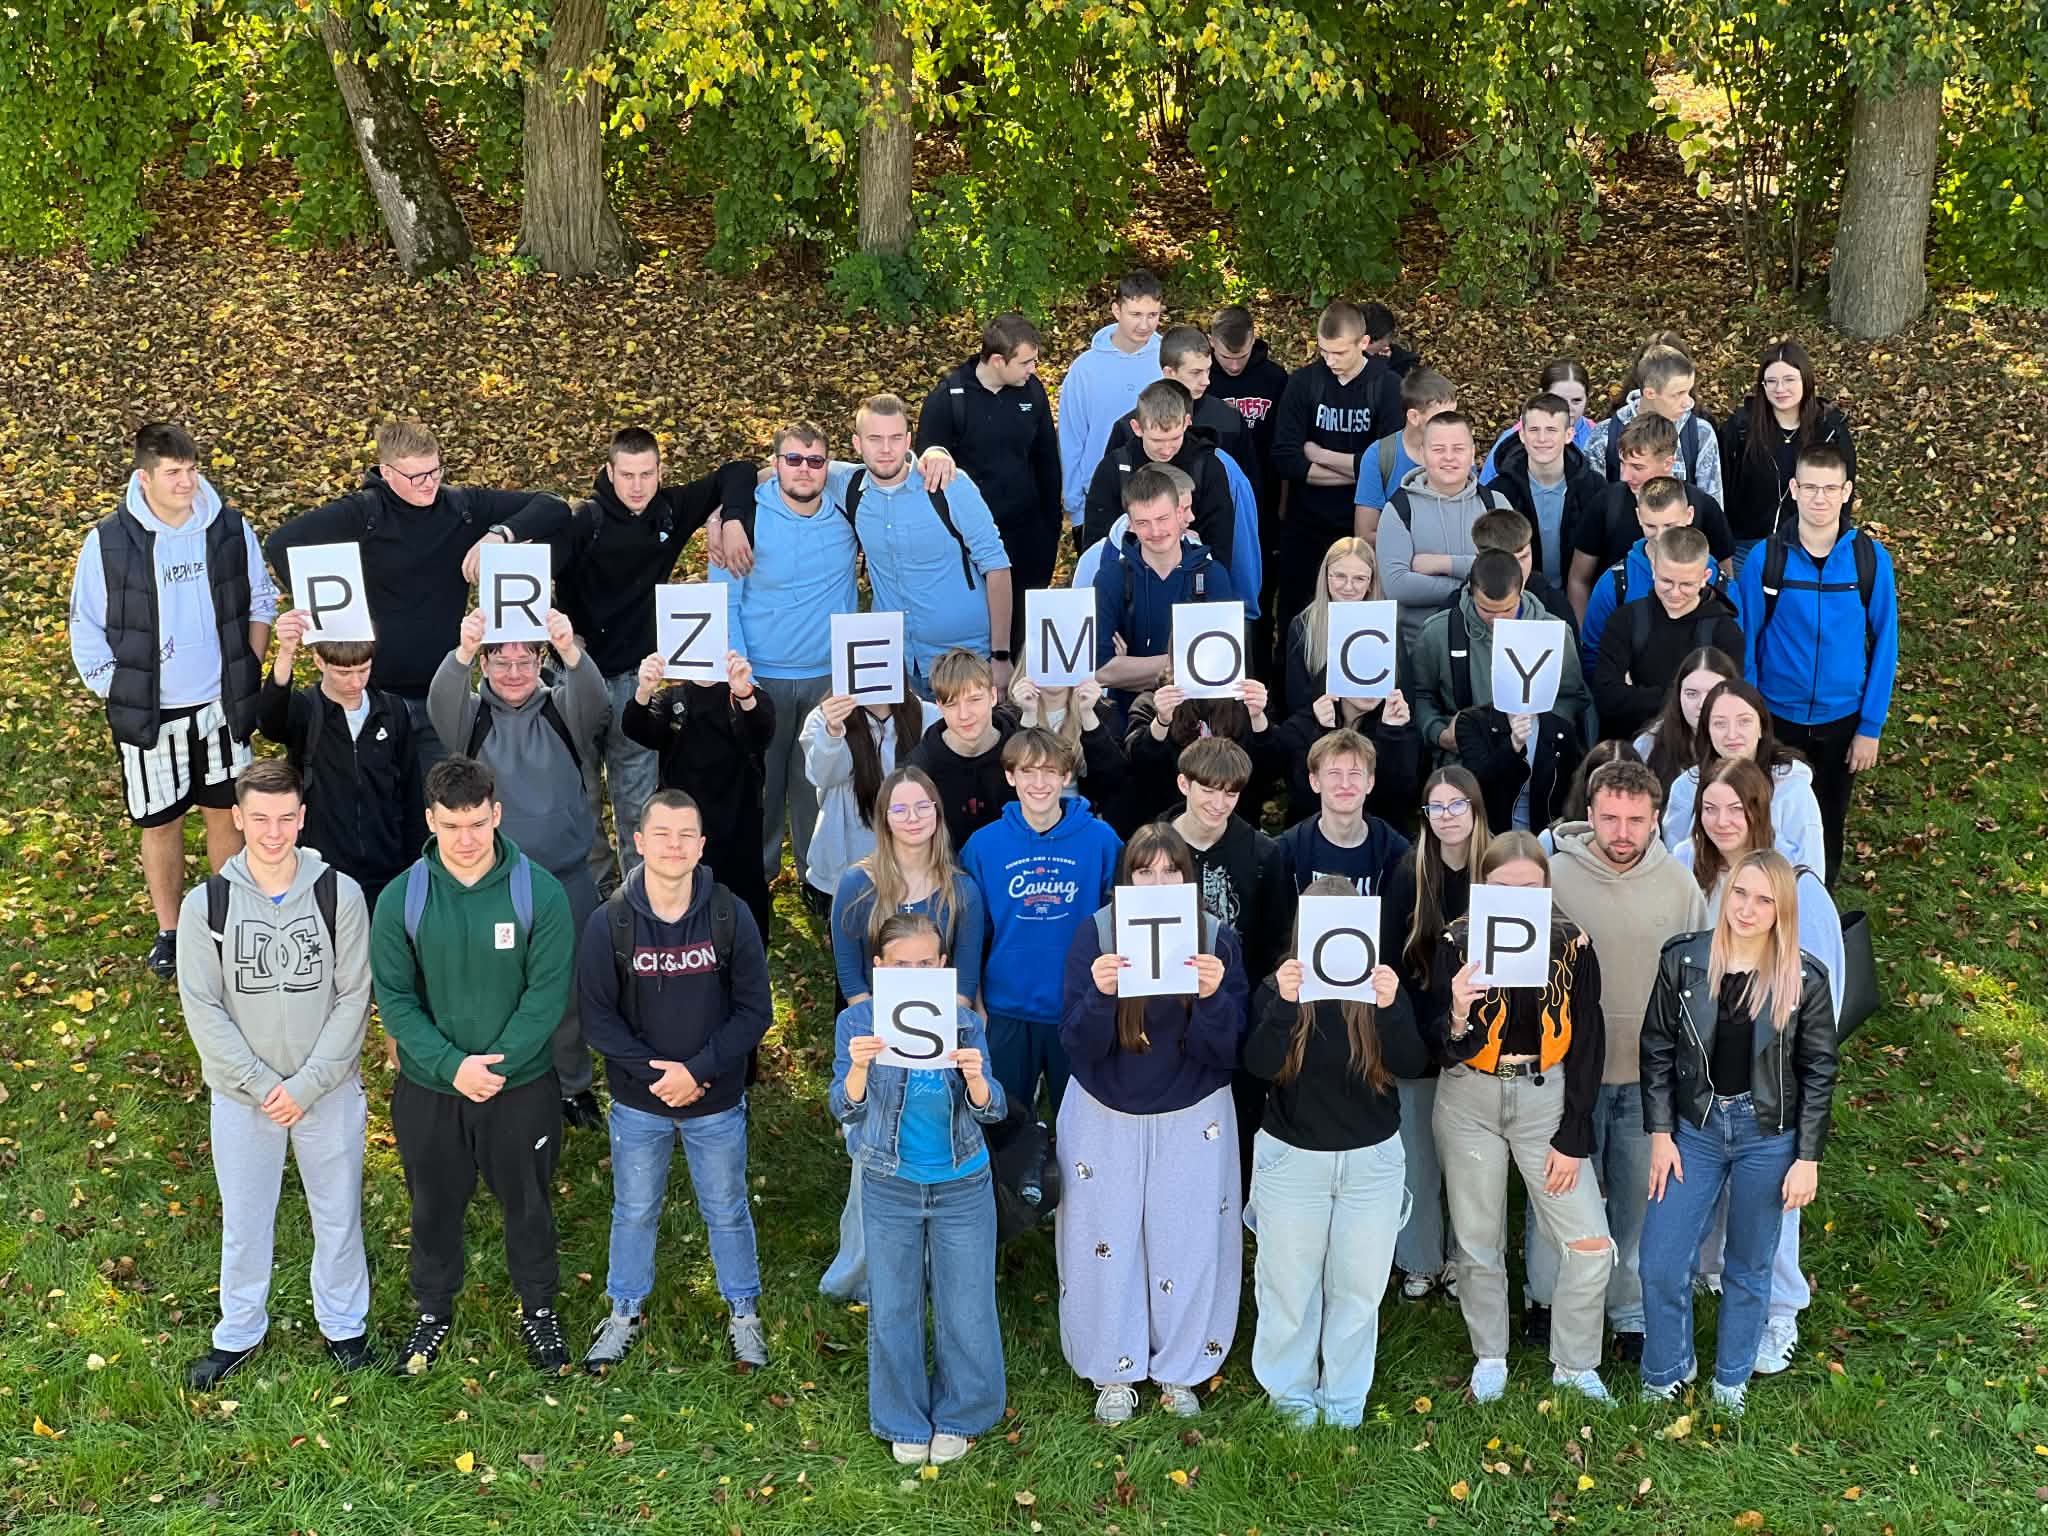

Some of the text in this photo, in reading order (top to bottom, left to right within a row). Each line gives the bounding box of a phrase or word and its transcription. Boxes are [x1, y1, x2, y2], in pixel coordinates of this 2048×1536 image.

[307, 575, 353, 631] P
[494, 573, 543, 629] R
[668, 612, 714, 668] Z
[847, 639, 893, 695] E
[1041, 616, 1094, 674] M
[1186, 630, 1243, 687] O
[1340, 629, 1390, 686] C
[1504, 647, 1553, 704] Y
[1008, 875, 1079, 903] Caving
[1128, 917, 1182, 980] T
[1312, 927, 1376, 987] O
[1485, 915, 1537, 975] P
[890, 1000, 944, 1060] S
